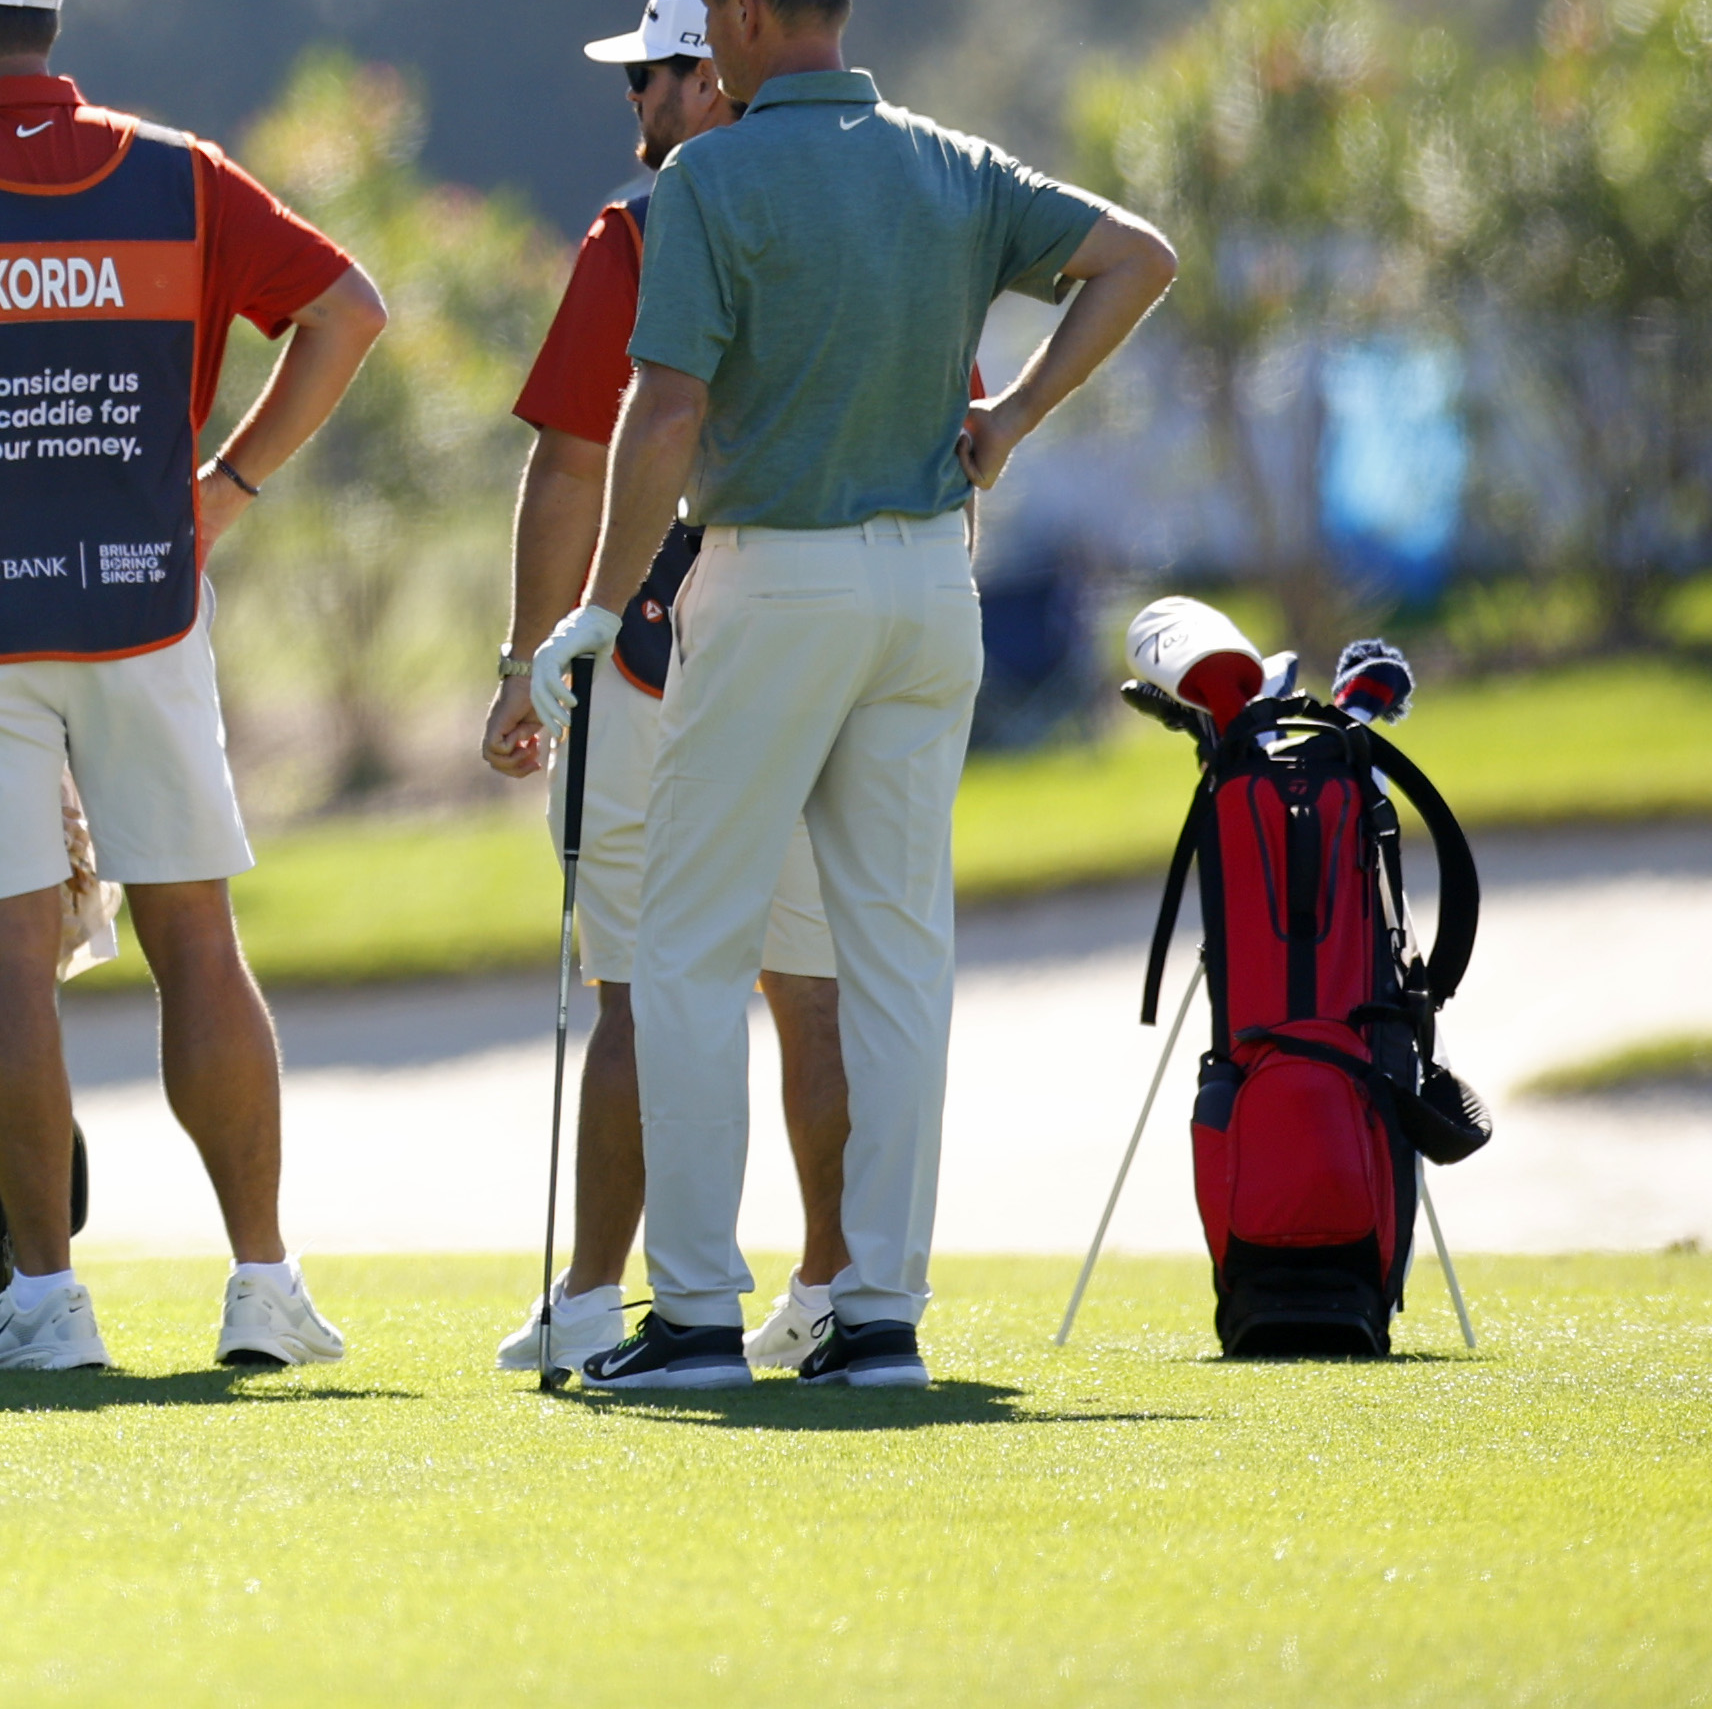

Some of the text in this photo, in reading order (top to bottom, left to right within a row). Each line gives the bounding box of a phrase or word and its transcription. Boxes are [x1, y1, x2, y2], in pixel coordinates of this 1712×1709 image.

[108, 373, 139, 393] us
[100, 399, 141, 425] for
[37, 436, 143, 463] money.
[99, 542, 172, 557] BRILLIANT
[100, 557, 159, 570] BORING
[101, 570, 145, 584] SINCE
